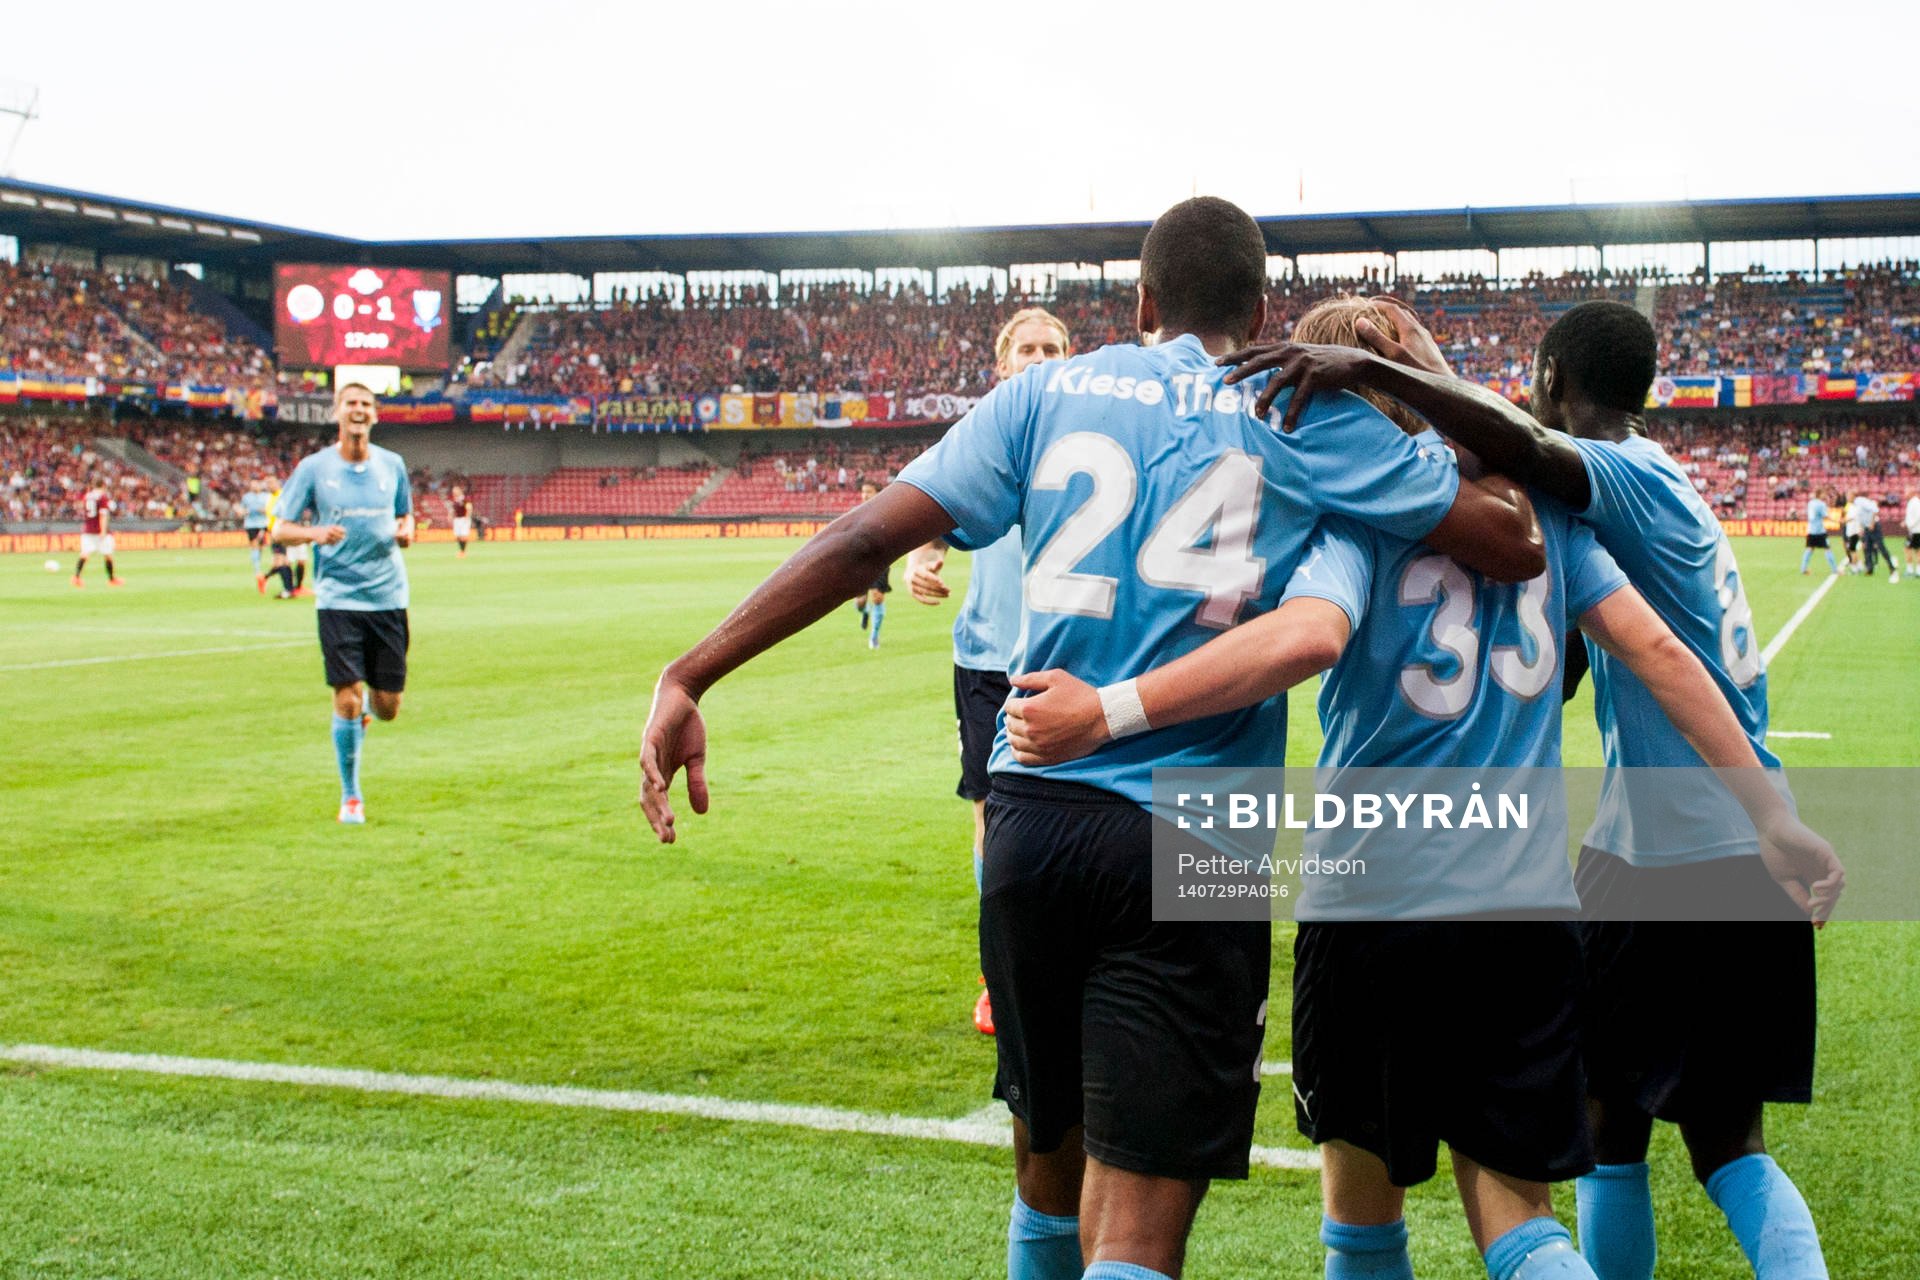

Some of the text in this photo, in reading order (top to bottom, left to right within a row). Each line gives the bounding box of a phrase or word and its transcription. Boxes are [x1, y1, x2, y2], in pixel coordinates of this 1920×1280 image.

[1046, 366, 1164, 405] Kiese
[1024, 431, 1266, 629] 24
[1399, 554, 1558, 721] 33
